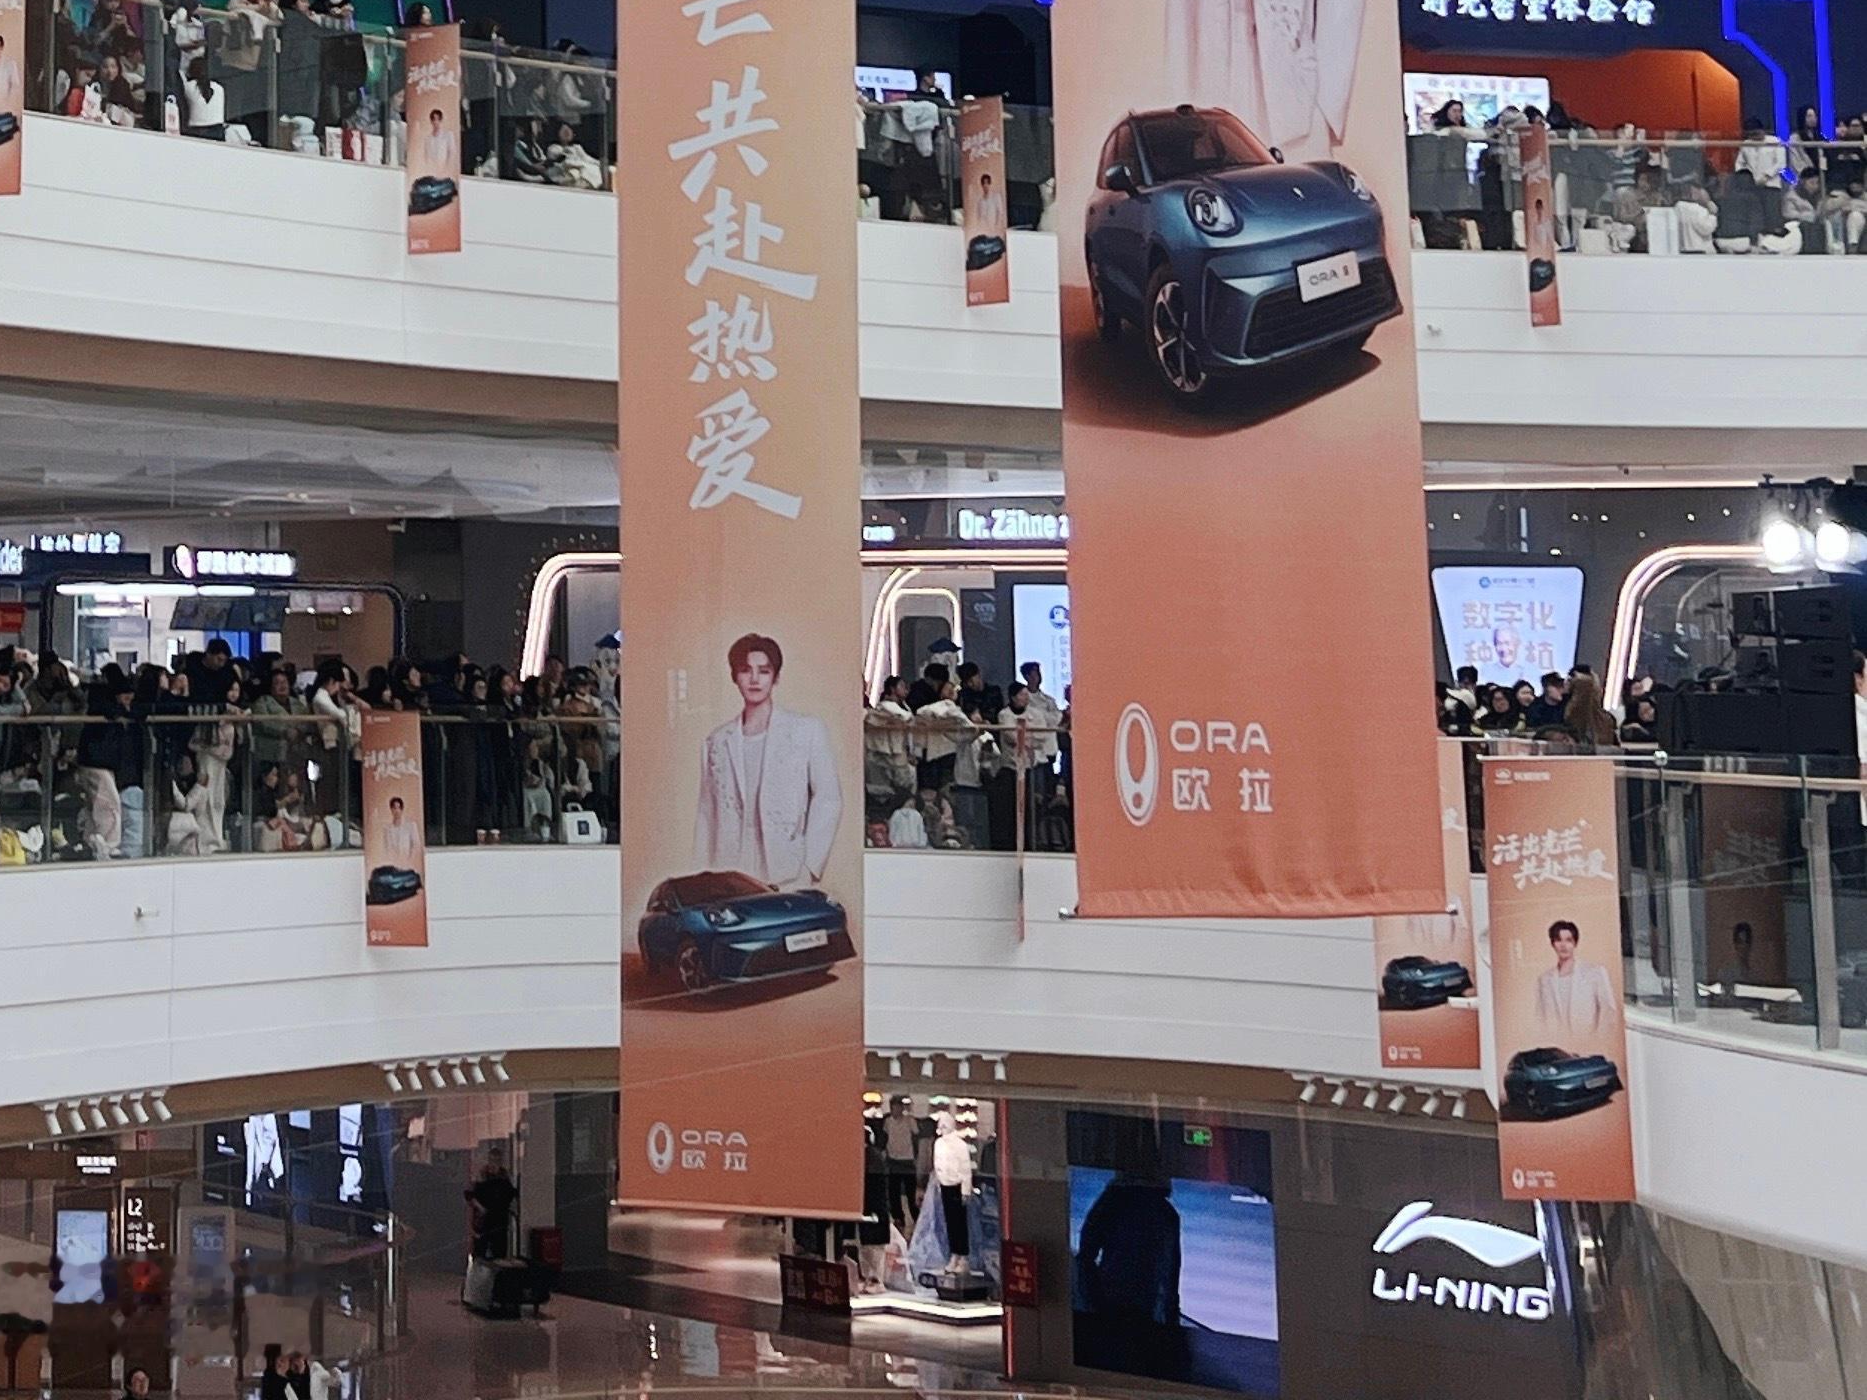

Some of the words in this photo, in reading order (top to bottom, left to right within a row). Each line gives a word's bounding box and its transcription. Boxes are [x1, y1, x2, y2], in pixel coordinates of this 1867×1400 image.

[1169, 719, 1271, 756] ORA
[1171, 767, 1273, 813] 欧拉
[681, 1130, 748, 1146] ORA
[1372, 1267, 1552, 1320] LI-NING
